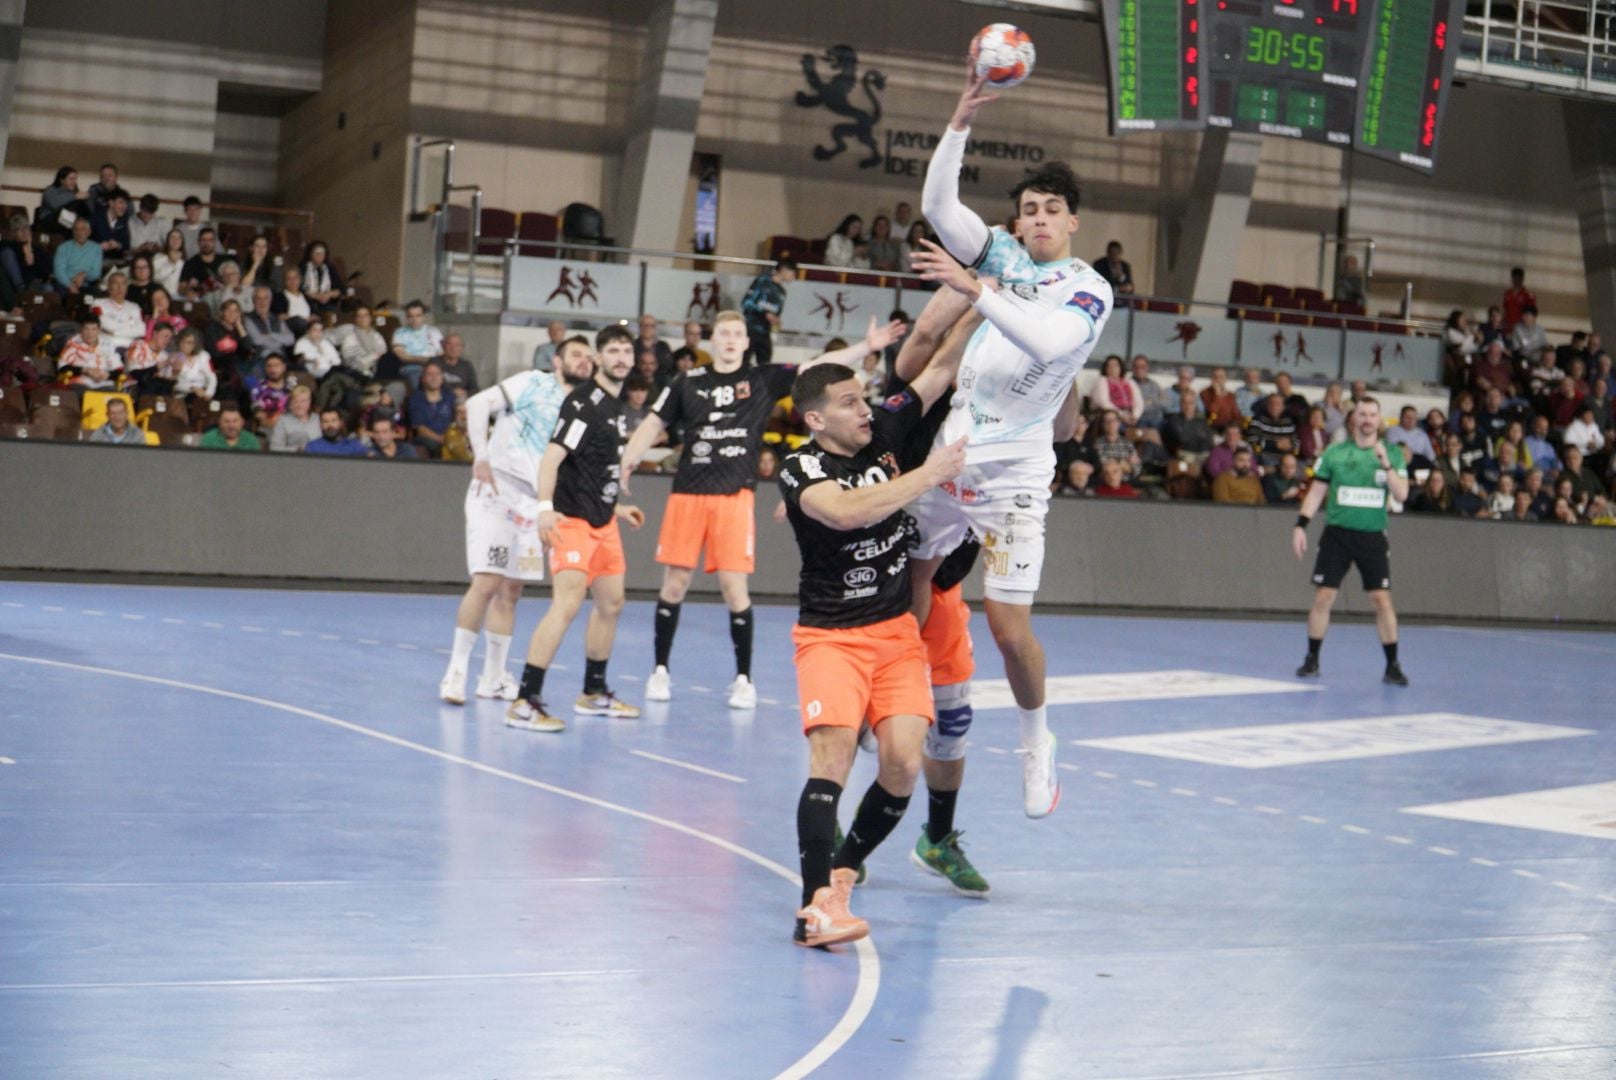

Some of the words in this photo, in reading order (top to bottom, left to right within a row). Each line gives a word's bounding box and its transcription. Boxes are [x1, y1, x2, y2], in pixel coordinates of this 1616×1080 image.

[1247, 26, 1325, 71] 30:55
[892, 156, 919, 177] DE
[711, 385, 735, 408] 18
[849, 570, 871, 584] SIG
[806, 699, 822, 719] 10
